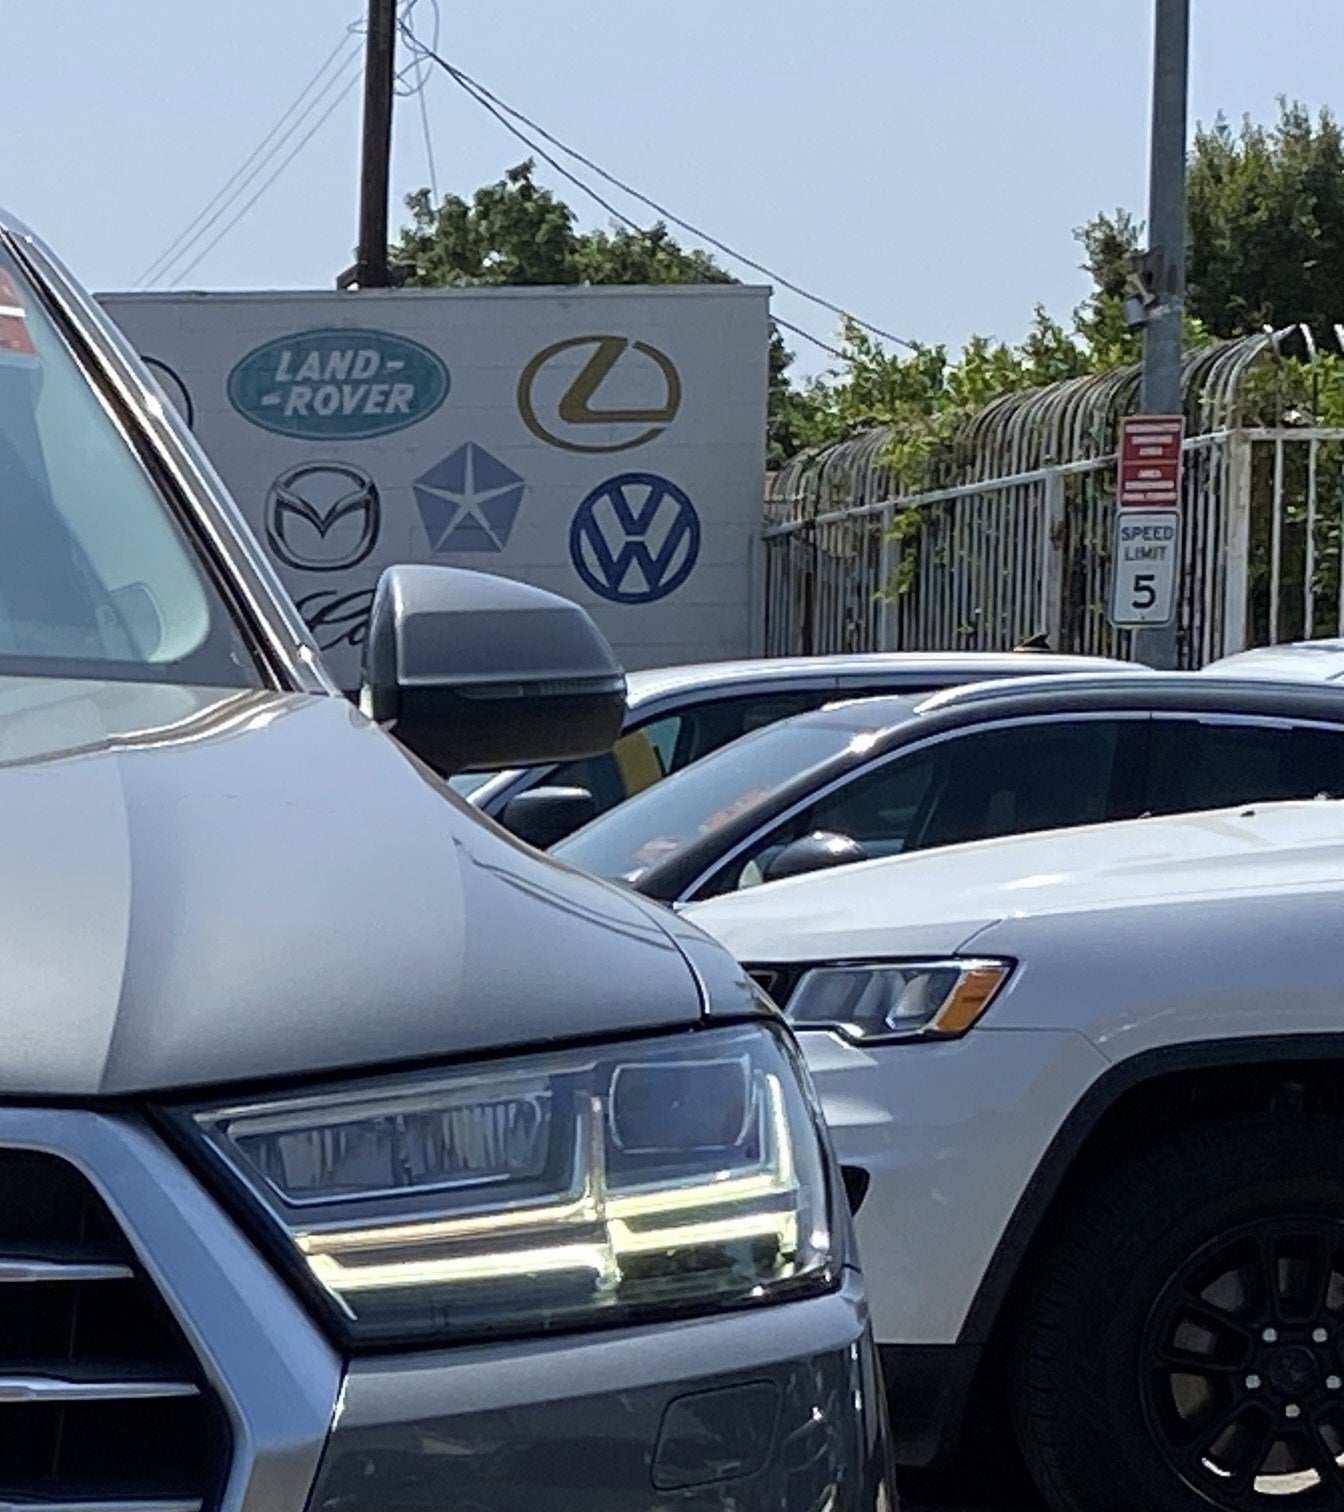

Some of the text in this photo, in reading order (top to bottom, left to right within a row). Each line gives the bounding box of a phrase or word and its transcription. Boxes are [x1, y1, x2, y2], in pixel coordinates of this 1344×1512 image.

[1121, 526, 1174, 542] SPEED
[1125, 546, 1169, 562] LIMIT
[1132, 574, 1156, 610] 5
